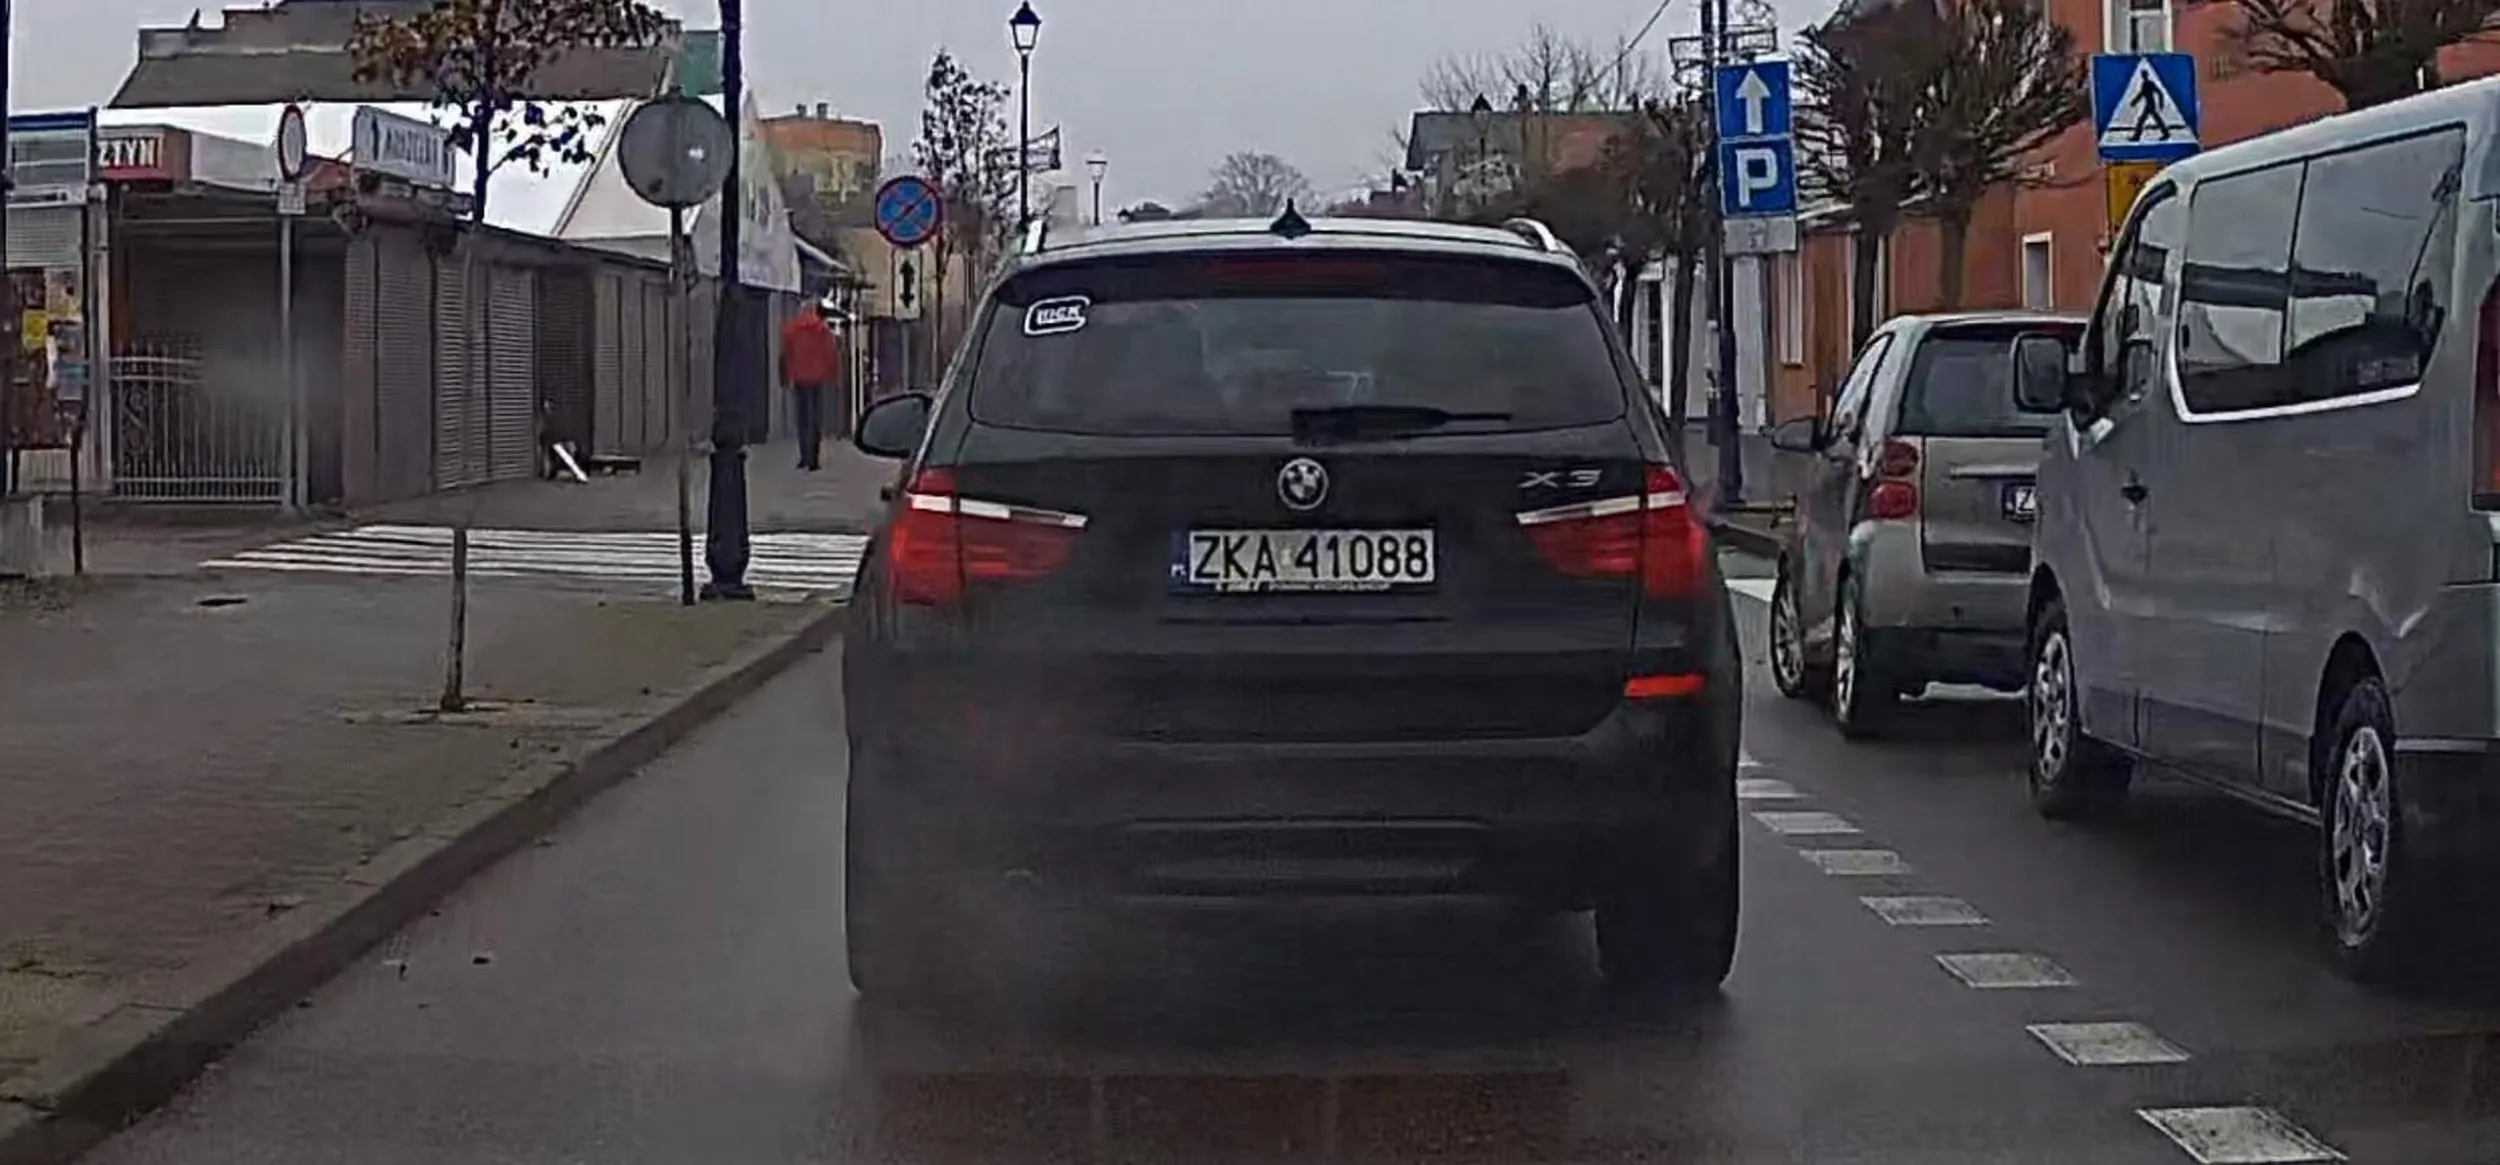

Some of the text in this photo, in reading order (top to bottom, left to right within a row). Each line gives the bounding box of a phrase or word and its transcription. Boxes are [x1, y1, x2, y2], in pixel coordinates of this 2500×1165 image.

[1735, 148, 1778, 208] P
[2017, 489, 2034, 512] Z
[1194, 534, 1428, 579] ZKA 41088
